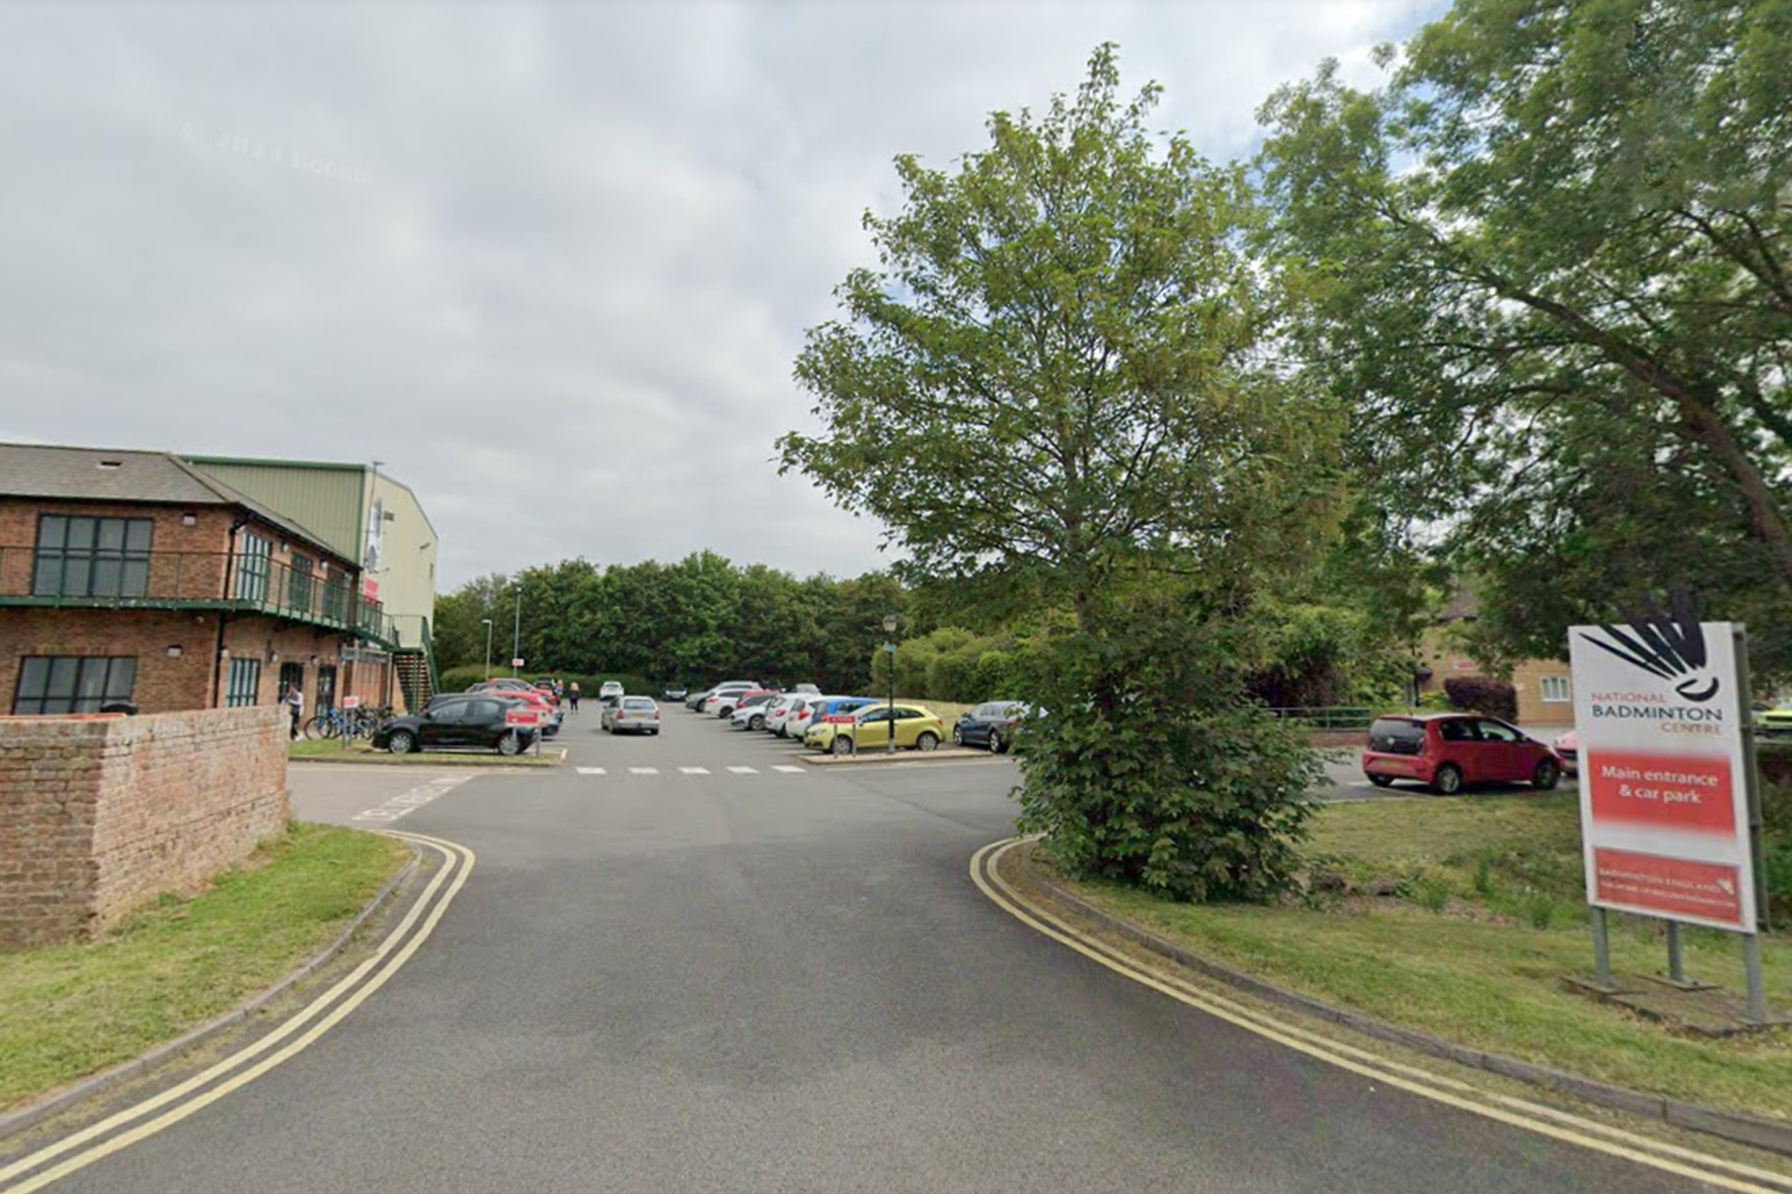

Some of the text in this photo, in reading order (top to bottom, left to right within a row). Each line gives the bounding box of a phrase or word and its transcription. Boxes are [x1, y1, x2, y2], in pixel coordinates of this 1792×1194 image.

[1591, 692, 1667, 703] NATIONAL
[1592, 705, 1723, 721] BADMINTON
[1661, 722, 1722, 735] CENTRE
[1602, 765, 1718, 787] Main entrance
[1619, 783, 1702, 804] & car park
